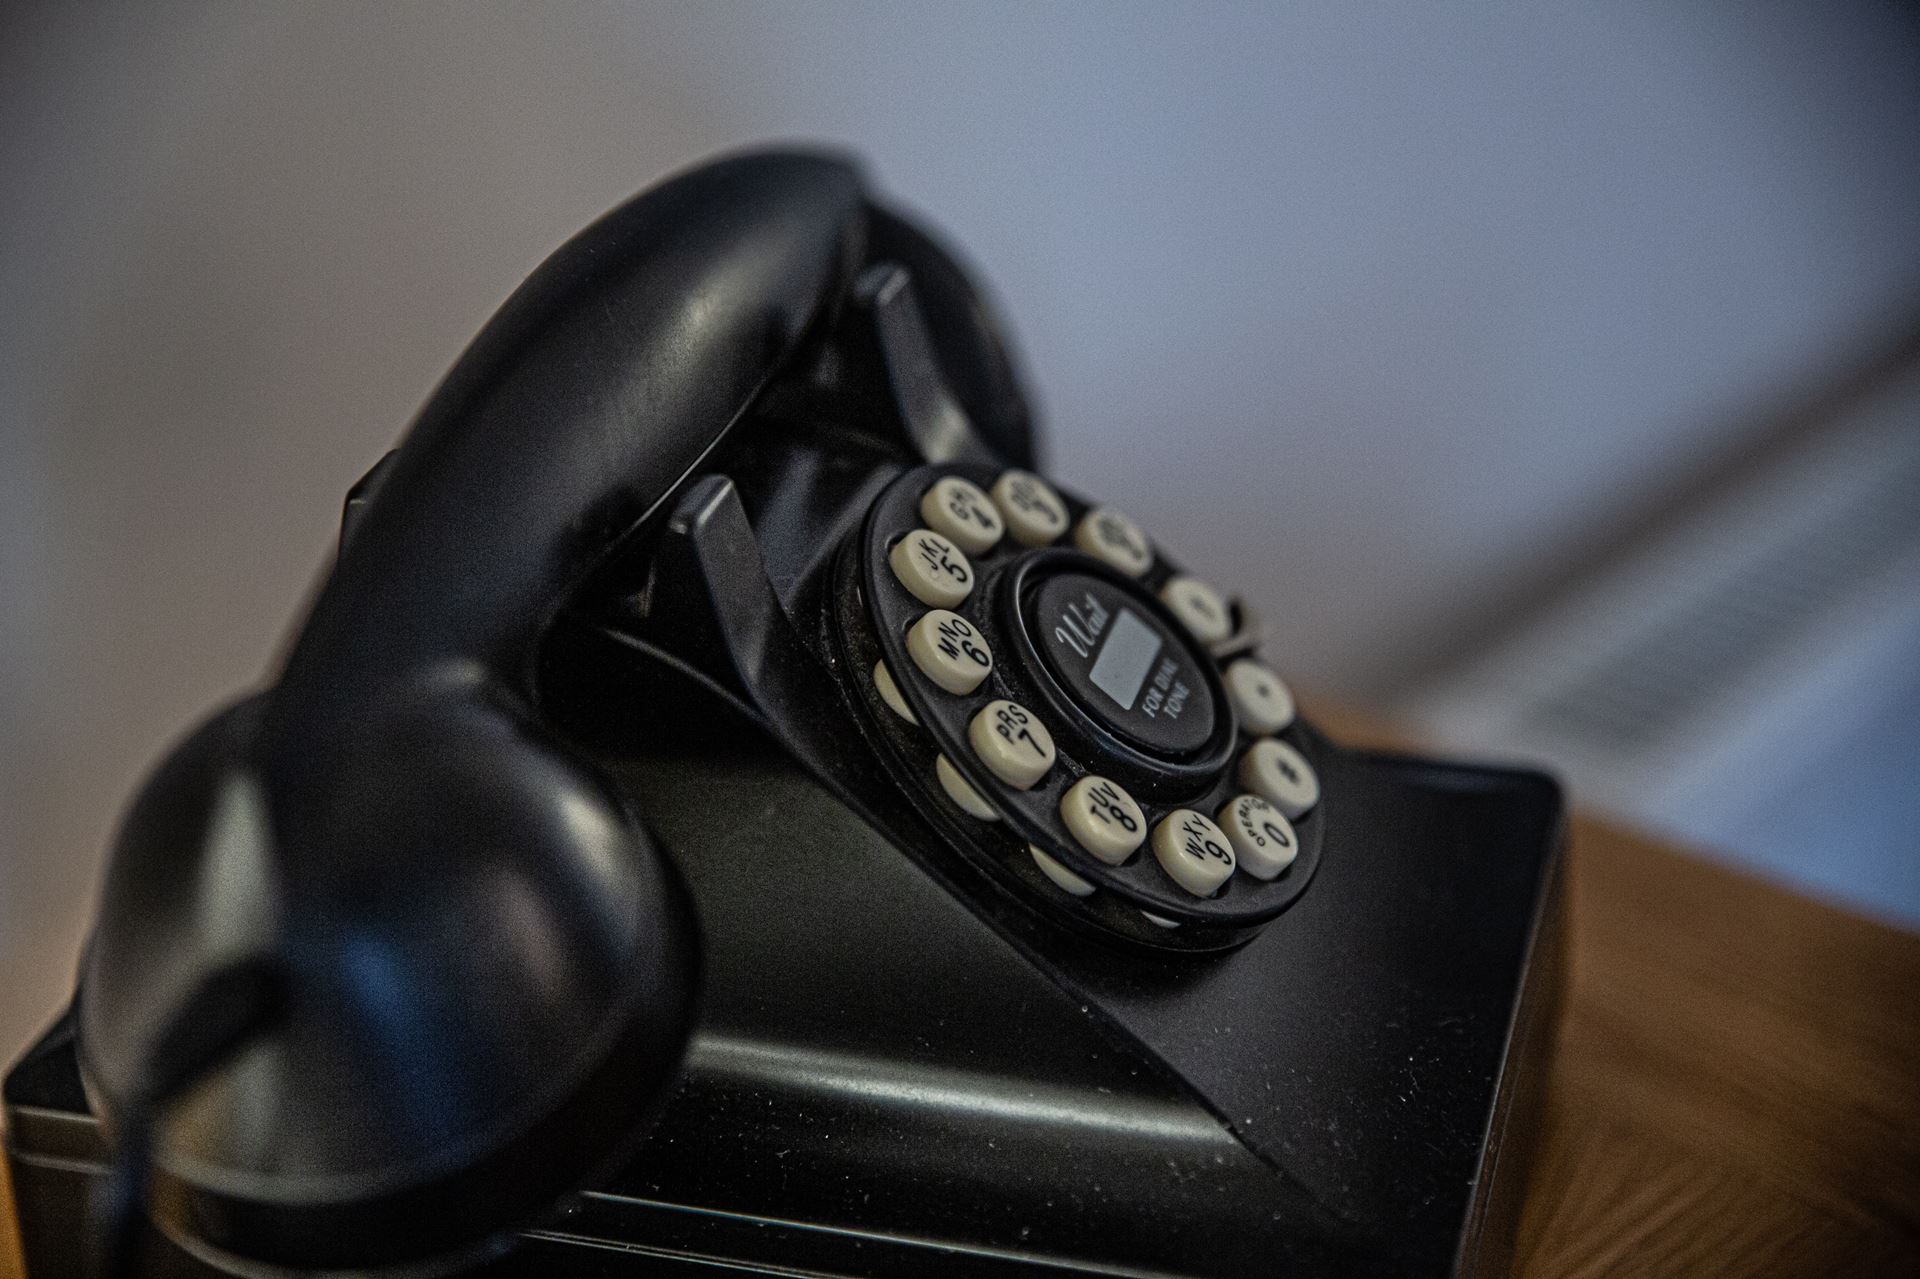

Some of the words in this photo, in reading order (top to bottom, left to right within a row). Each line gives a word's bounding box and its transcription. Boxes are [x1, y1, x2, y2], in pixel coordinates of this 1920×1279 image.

[971, 506, 996, 529] 4
[918, 538, 949, 571] JKL
[940, 551, 968, 583] 5
[938, 619, 972, 660] MNO
[1055, 594, 1109, 658] Wait
[961, 640, 990, 667] 6
[1142, 686, 1164, 718] FOR
[1163, 681, 1190, 719] TONE
[996, 704, 1029, 745] PRS
[1018, 729, 1046, 758] 7
[1088, 781, 1120, 824] TUV
[1110, 805, 1137, 832] 8
[1183, 813, 1211, 861] WXY
[1239, 798, 1270, 847] OPERATOR
[1264, 822, 1290, 847] 0
[1205, 840, 1232, 866] 9
